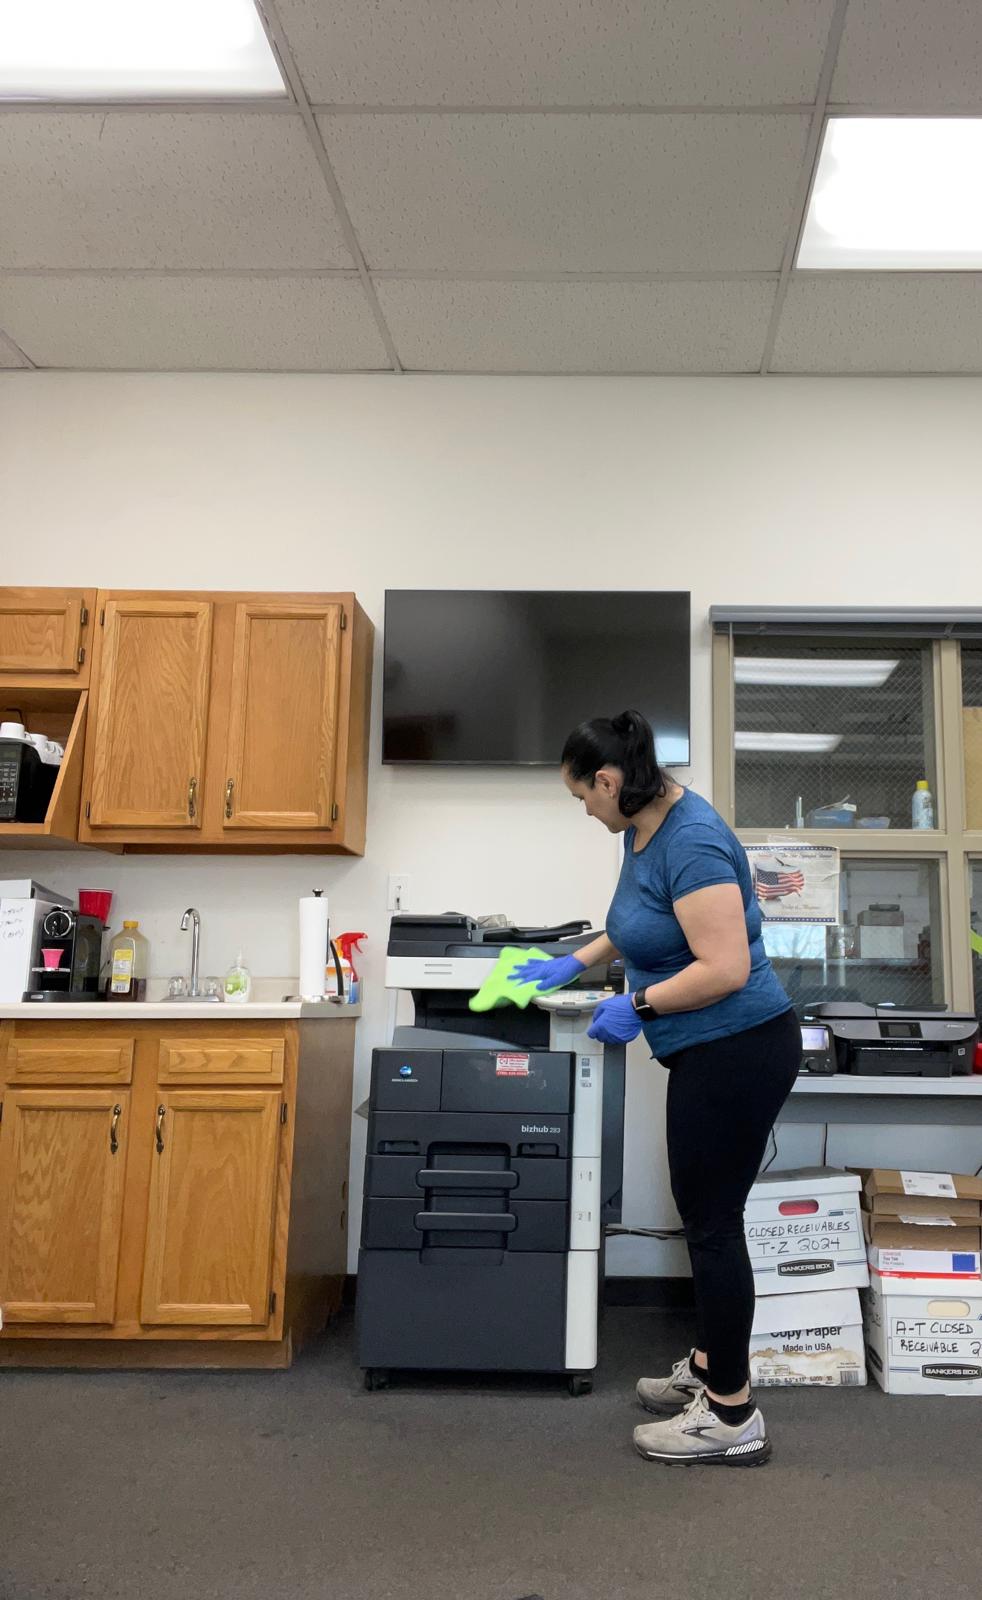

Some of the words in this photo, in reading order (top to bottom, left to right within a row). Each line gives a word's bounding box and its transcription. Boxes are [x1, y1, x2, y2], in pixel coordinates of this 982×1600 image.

[521, 1125, 549, 1133] bizhub
[749, 1227, 785, 1238] CLOSED
[787, 1221, 850, 1235] RECEIVABLES
[756, 1241, 789, 1255] T-Z
[797, 1237, 840, 1252] 2024
[781, 1264, 815, 1272] BANKERS
[806, 1326, 842, 1338] Paper
[896, 1321, 926, 1336] A-T
[930, 1322, 973, 1335] CLOSED
[782, 1344, 803, 1352] Made
[805, 1343, 813, 1351] in
[814, 1343, 832, 1351] USA
[900, 1339, 959, 1354] RECEIVABLE
